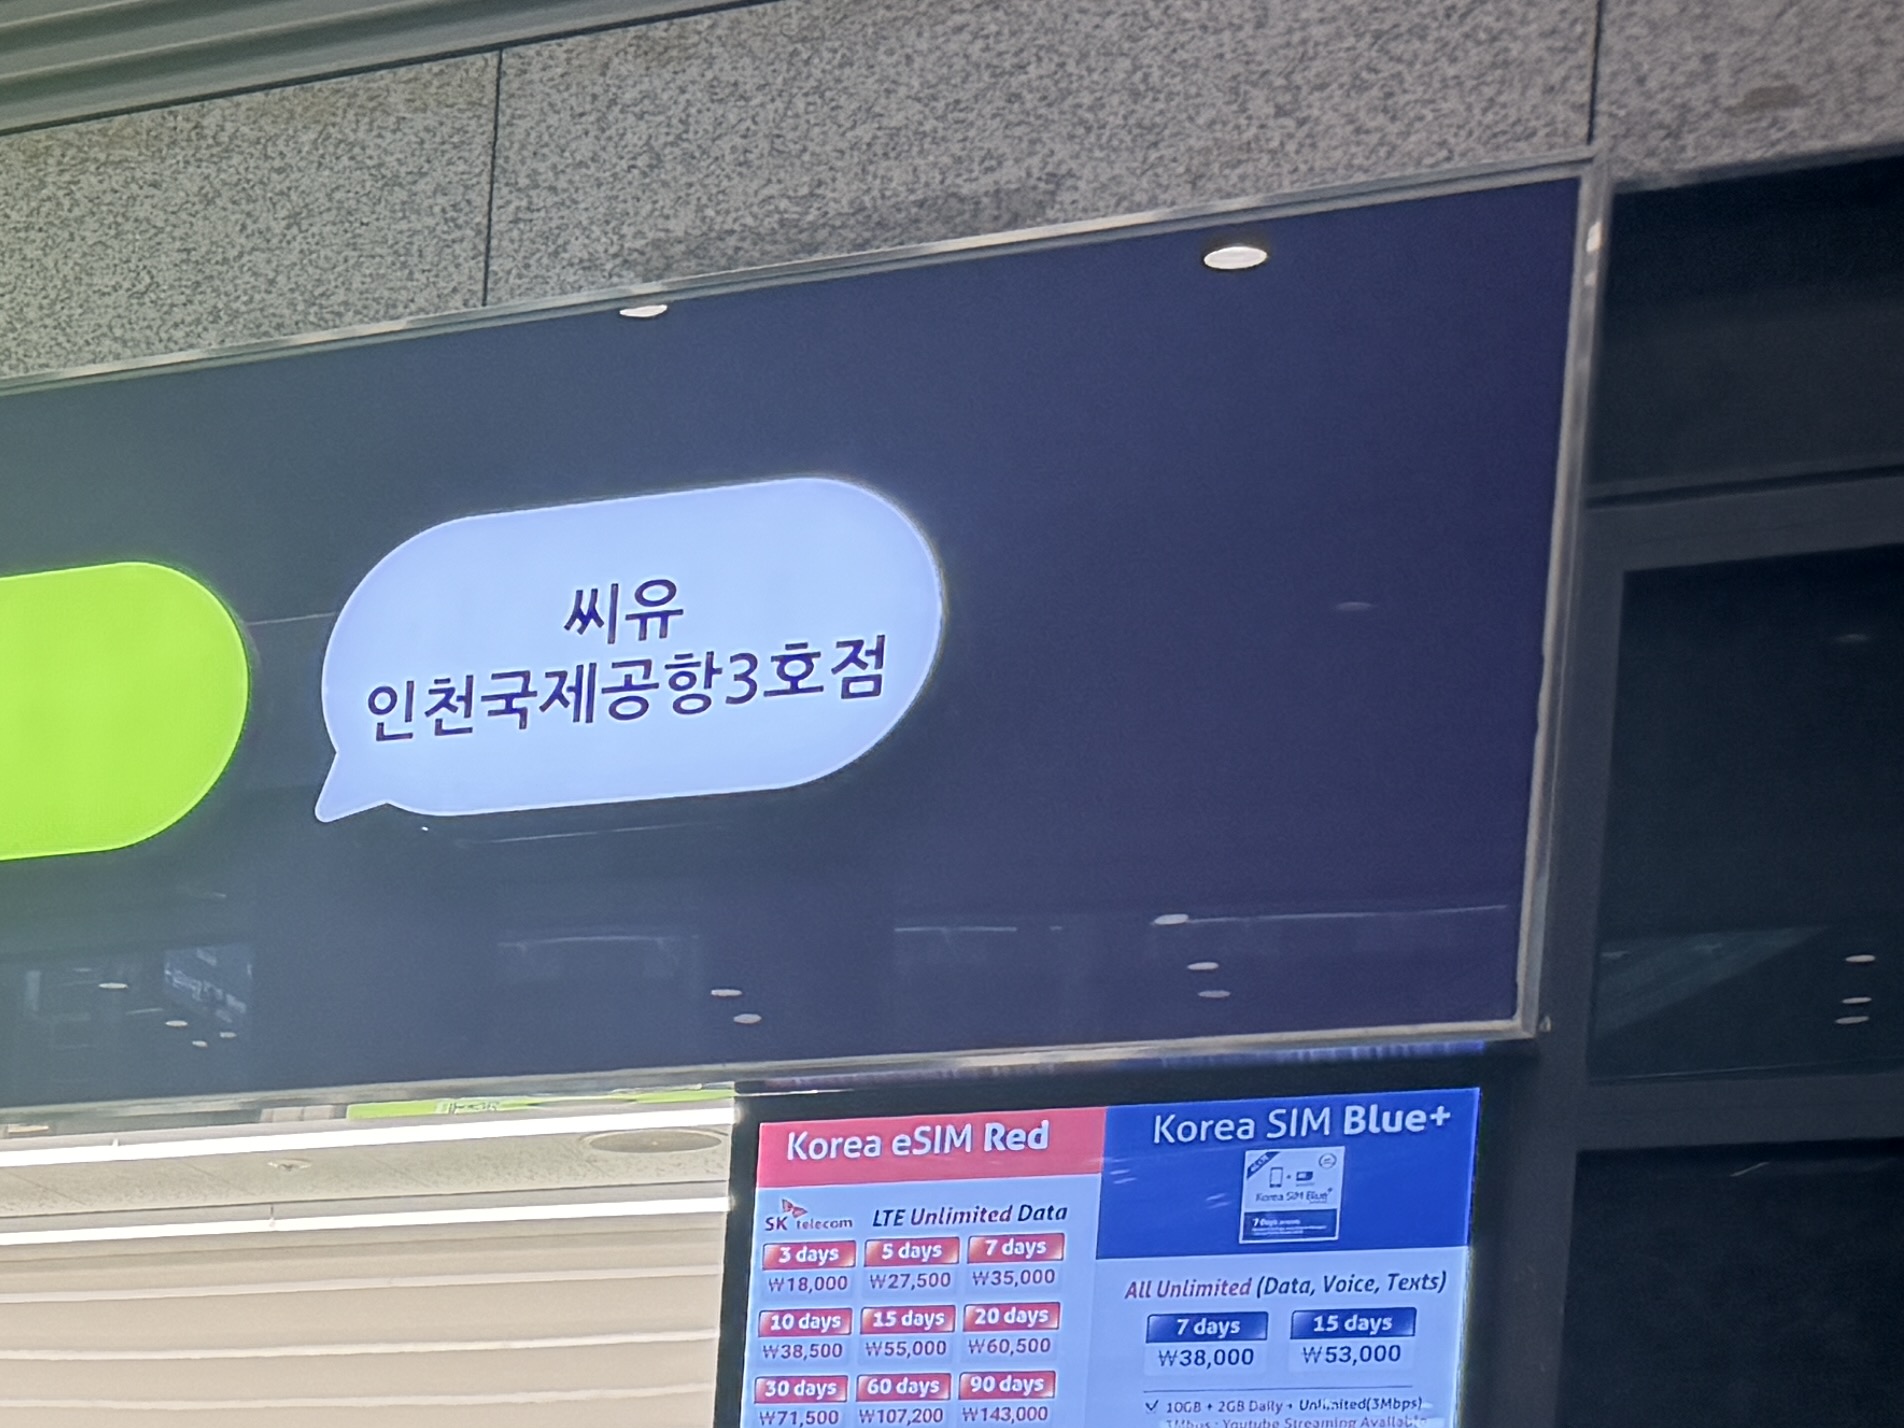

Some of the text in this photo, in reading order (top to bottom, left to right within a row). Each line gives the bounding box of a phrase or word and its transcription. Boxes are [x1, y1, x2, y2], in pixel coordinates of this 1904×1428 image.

[563, 577, 684, 645] 씨유
[366, 634, 888, 743] 인천국제공항3호점
[1153, 1104, 1451, 1144] Korea SIM Blue+
[787, 1120, 1050, 1161] Korea eSIM Red
[764, 1216, 854, 1231] SK telecom
[872, 1203, 1068, 1228] LTE Unlimited Data
[779, 1245, 840, 1266] 3 days
[882, 1242, 943, 1263] 5 days
[985, 1237, 1047, 1258] 7 days
[768, 1275, 848, 1293] ₩18,000
[869, 1272, 951, 1290] ₩27,500
[972, 1269, 1056, 1287] ₩35,000
[1125, 1272, 1447, 1299] All Unlimited (Data, Voice, Texts)
[771, 1312, 842, 1333] 10 days
[872, 1310, 945, 1330] 15 days
[974, 1306, 1050, 1327] 20 days
[1313, 1314, 1393, 1335] 15 days
[1176, 1317, 1241, 1338] 7 days
[762, 1342, 843, 1360] ₩38,500
[865, 1340, 948, 1358] ₩55,000
[968, 1337, 1051, 1355] ₩60,500
[1303, 1345, 1401, 1364] ₩53,000
[1158, 1348, 1255, 1367] ₩38,000
[764, 1378, 838, 1400] 30 days
[867, 1376, 940, 1398] 60 days
[970, 1374, 1045, 1395] 90 days
[759, 1409, 840, 1427] ₩71,500
[859, 1407, 945, 1425] ₩107,200
[962, 1404, 1049, 1423] ₩143,000
